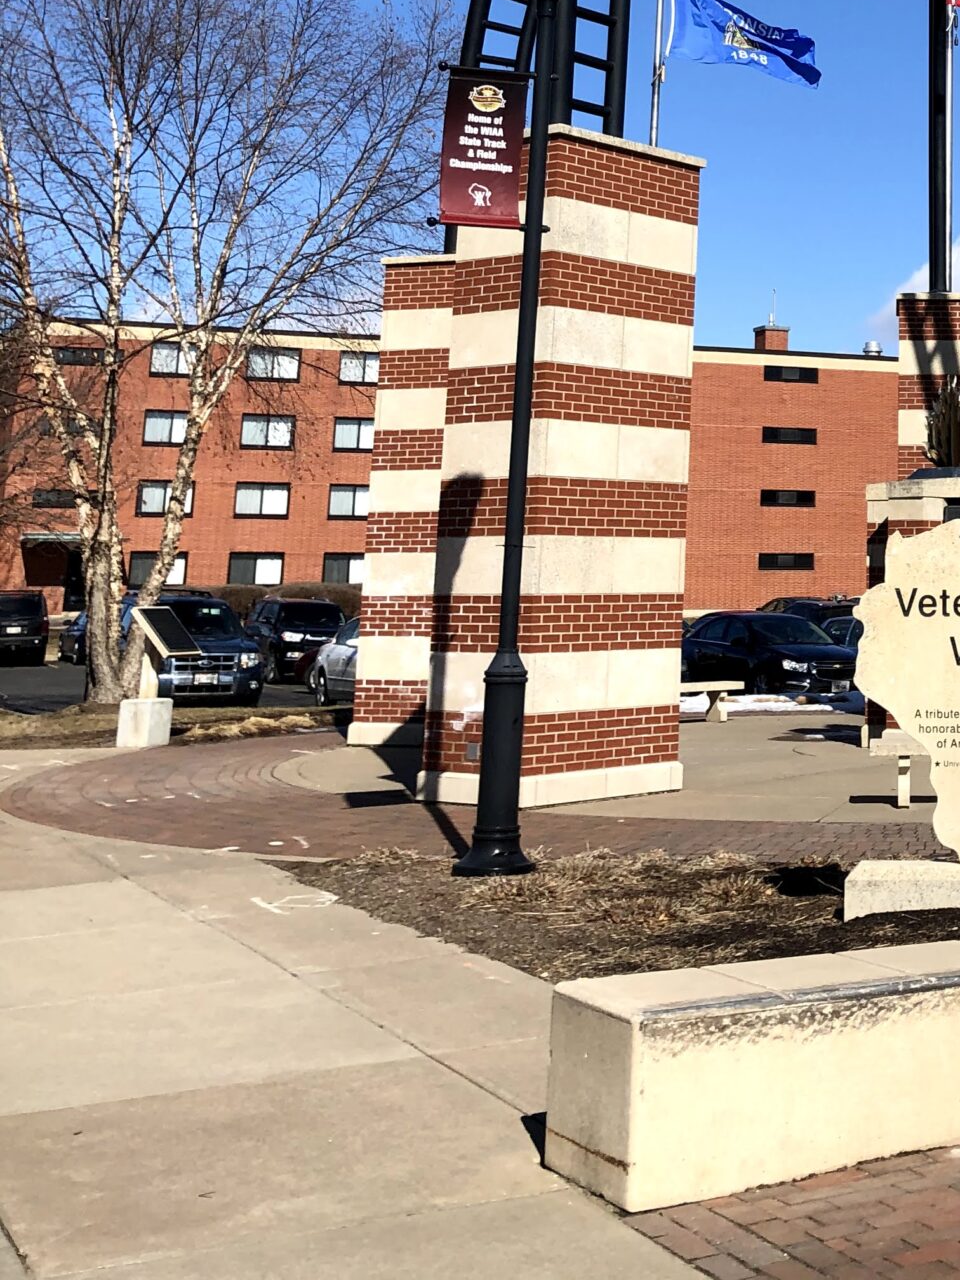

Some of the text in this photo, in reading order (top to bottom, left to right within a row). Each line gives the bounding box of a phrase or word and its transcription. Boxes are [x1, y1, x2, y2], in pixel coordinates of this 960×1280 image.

[731, 50, 768, 65] 1848
[467, 113, 503, 125] Home of
[464, 124, 504, 137] the WIAA
[459, 135, 507, 149] State Track
[476, 149, 497, 159] Field
[449, 158, 513, 174] Championships
[914, 709, 922, 719] A
[925, 709, 960, 719] tribute
[936, 738, 947, 748] of
